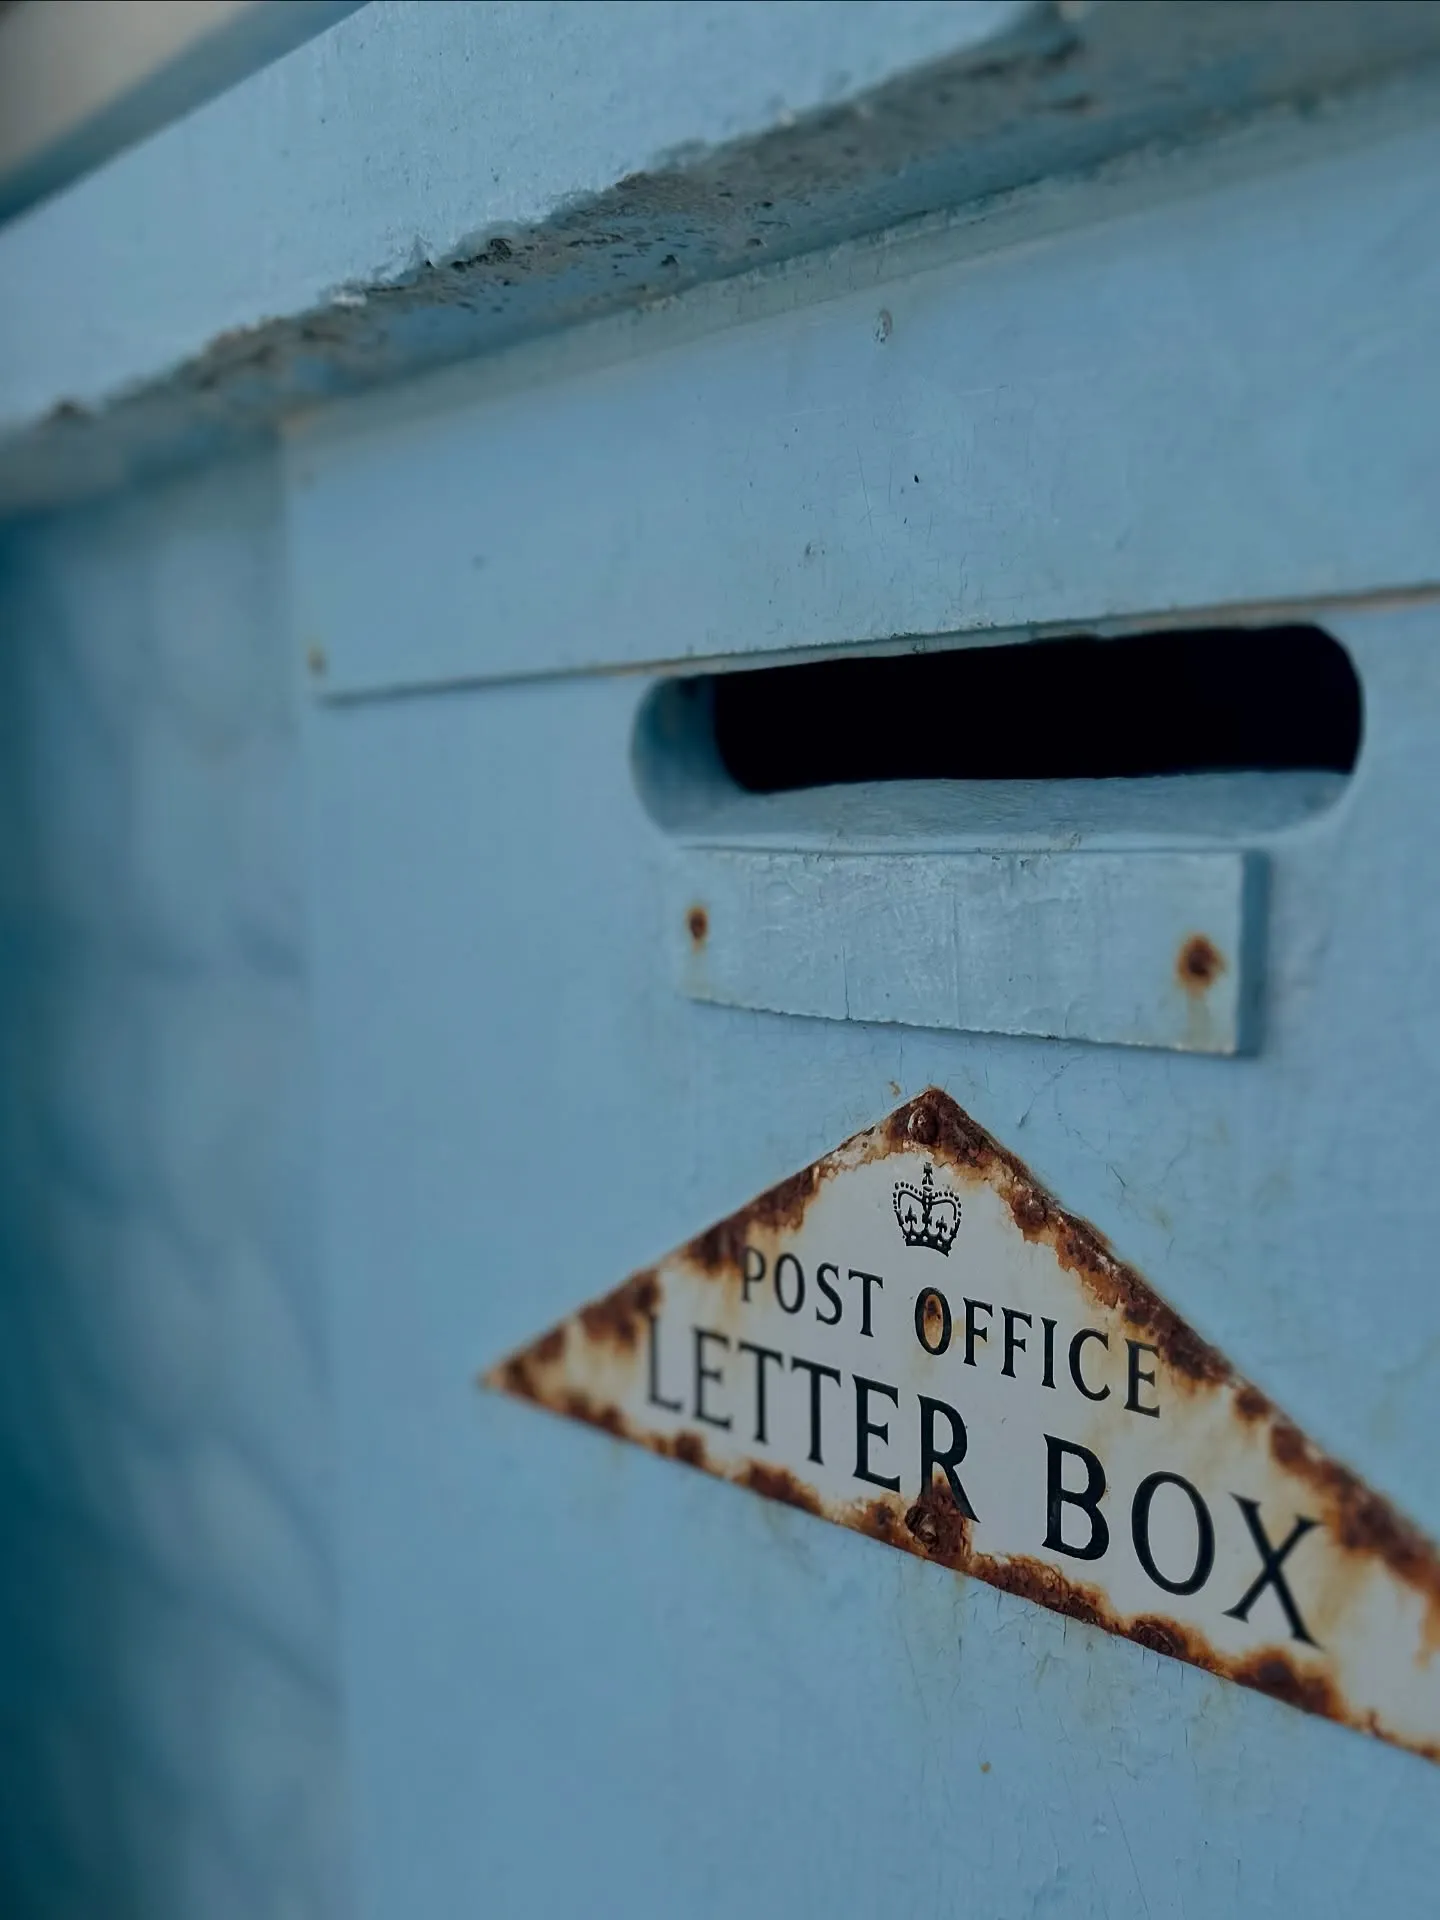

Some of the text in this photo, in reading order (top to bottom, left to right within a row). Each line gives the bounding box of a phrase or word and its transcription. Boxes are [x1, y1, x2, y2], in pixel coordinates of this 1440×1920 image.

[741, 1246, 1161, 1419] POST OFFICE
[645, 1313, 1326, 1653] LETTER BOX
